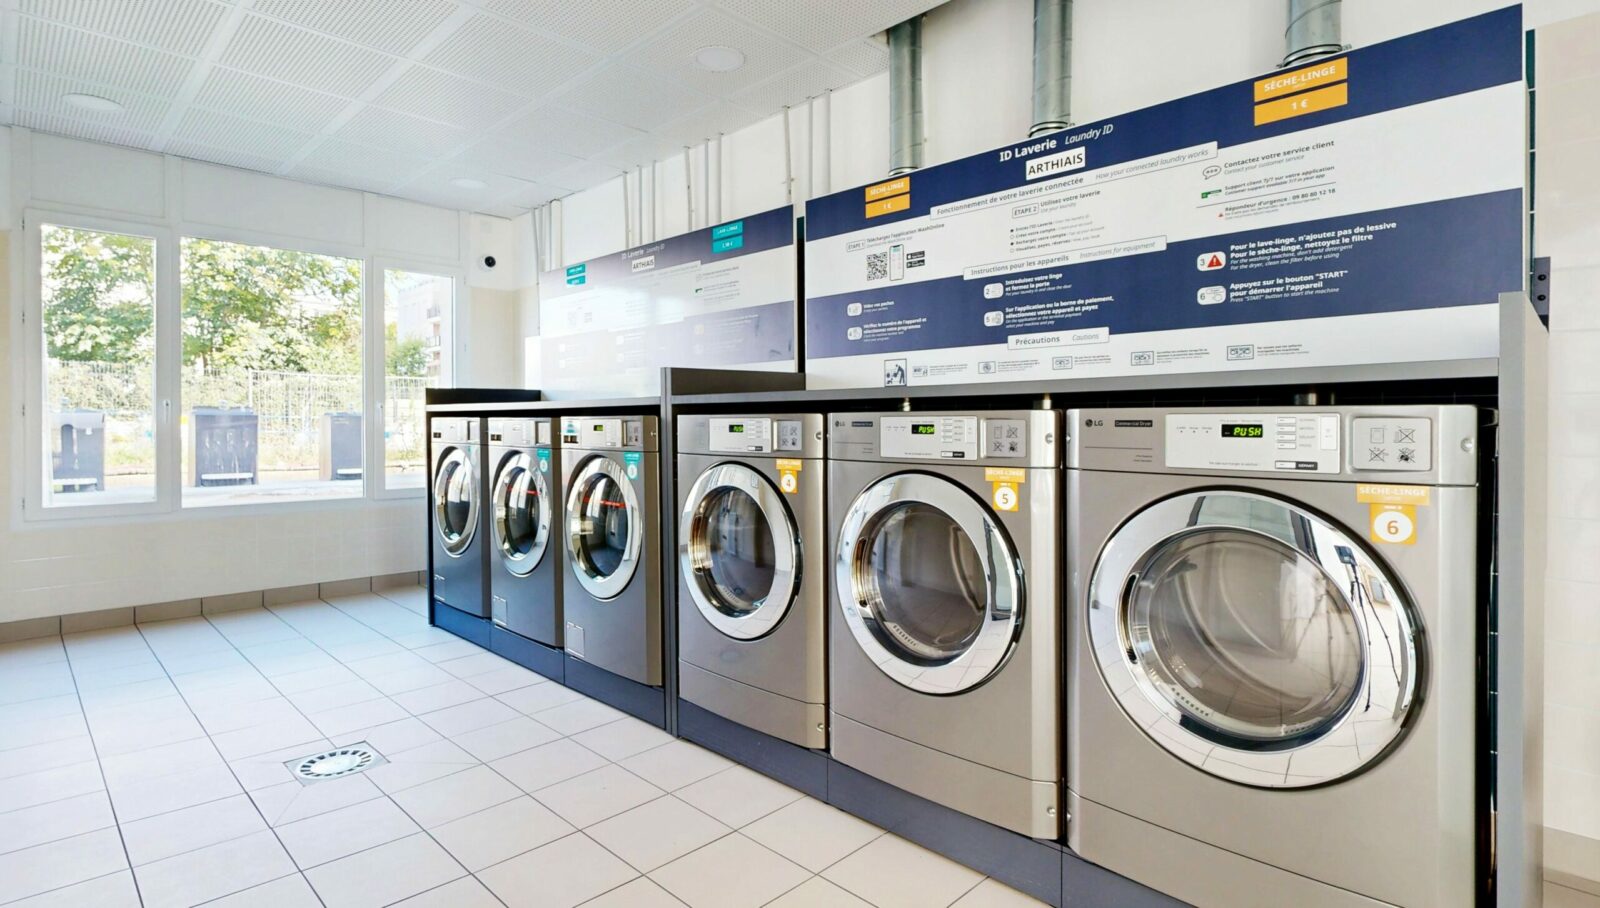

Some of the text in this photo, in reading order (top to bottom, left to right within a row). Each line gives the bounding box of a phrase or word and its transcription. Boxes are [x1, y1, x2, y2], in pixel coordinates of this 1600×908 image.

[1264, 66, 1336, 92] SÈCHE-LINGE
[1291, 98, 1308, 110] 1 €
[1000, 124, 1114, 161] ID Laverie Laundry ID
[1224, 157, 1259, 168] Contactez
[1283, 146, 1310, 156] service
[1312, 140, 1334, 150] client
[1028, 153, 1083, 176] ARTHIAIS
[1110, 169, 1124, 178] your
[1126, 160, 1158, 172] connected
[1160, 156, 1186, 165] laundry
[1188, 150, 1209, 159] works
[1225, 182, 1245, 191] Support
[1302, 166, 1334, 176] application
[937, 198, 988, 214] Fonctionnement
[999, 193, 1017, 201] votre
[1019, 187, 1043, 197] laverie
[1045, 178, 1083, 191] connectée
[1080, 190, 1100, 198] laverie
[1225, 203, 1256, 212] Répondeur
[1258, 197, 1287, 206] d'urgence
[1257, 238, 1296, 247] lave-linge,
[1298, 232, 1335, 241] n'ajoutez
[1367, 223, 1396, 232] lessive
[1080, 250, 1112, 259] Instructions
[1124, 242, 1155, 253] equipment
[1257, 245, 1302, 254] sèche-linge,
[1305, 240, 1340, 248] nettoyez
[632, 259, 654, 270] ARTHIAIS
[971, 265, 1008, 275] Instructions
[1010, 263, 1024, 271] pour
[1037, 255, 1069, 266] appareils
[1230, 282, 1260, 290] Appuyez
[1315, 271, 1348, 279] "START"
[1286, 282, 1323, 291] l'appareil
[1015, 304, 1045, 312] l'application
[1085, 296, 1114, 305] paiement,
[1052, 307, 1074, 315] appareil
[1015, 336, 1060, 345] Précautions
[918, 425, 934, 433] PUSH
[1233, 427, 1261, 436] PUSH
[1002, 494, 1008, 504] 5
[1387, 520, 1399, 534] 6
